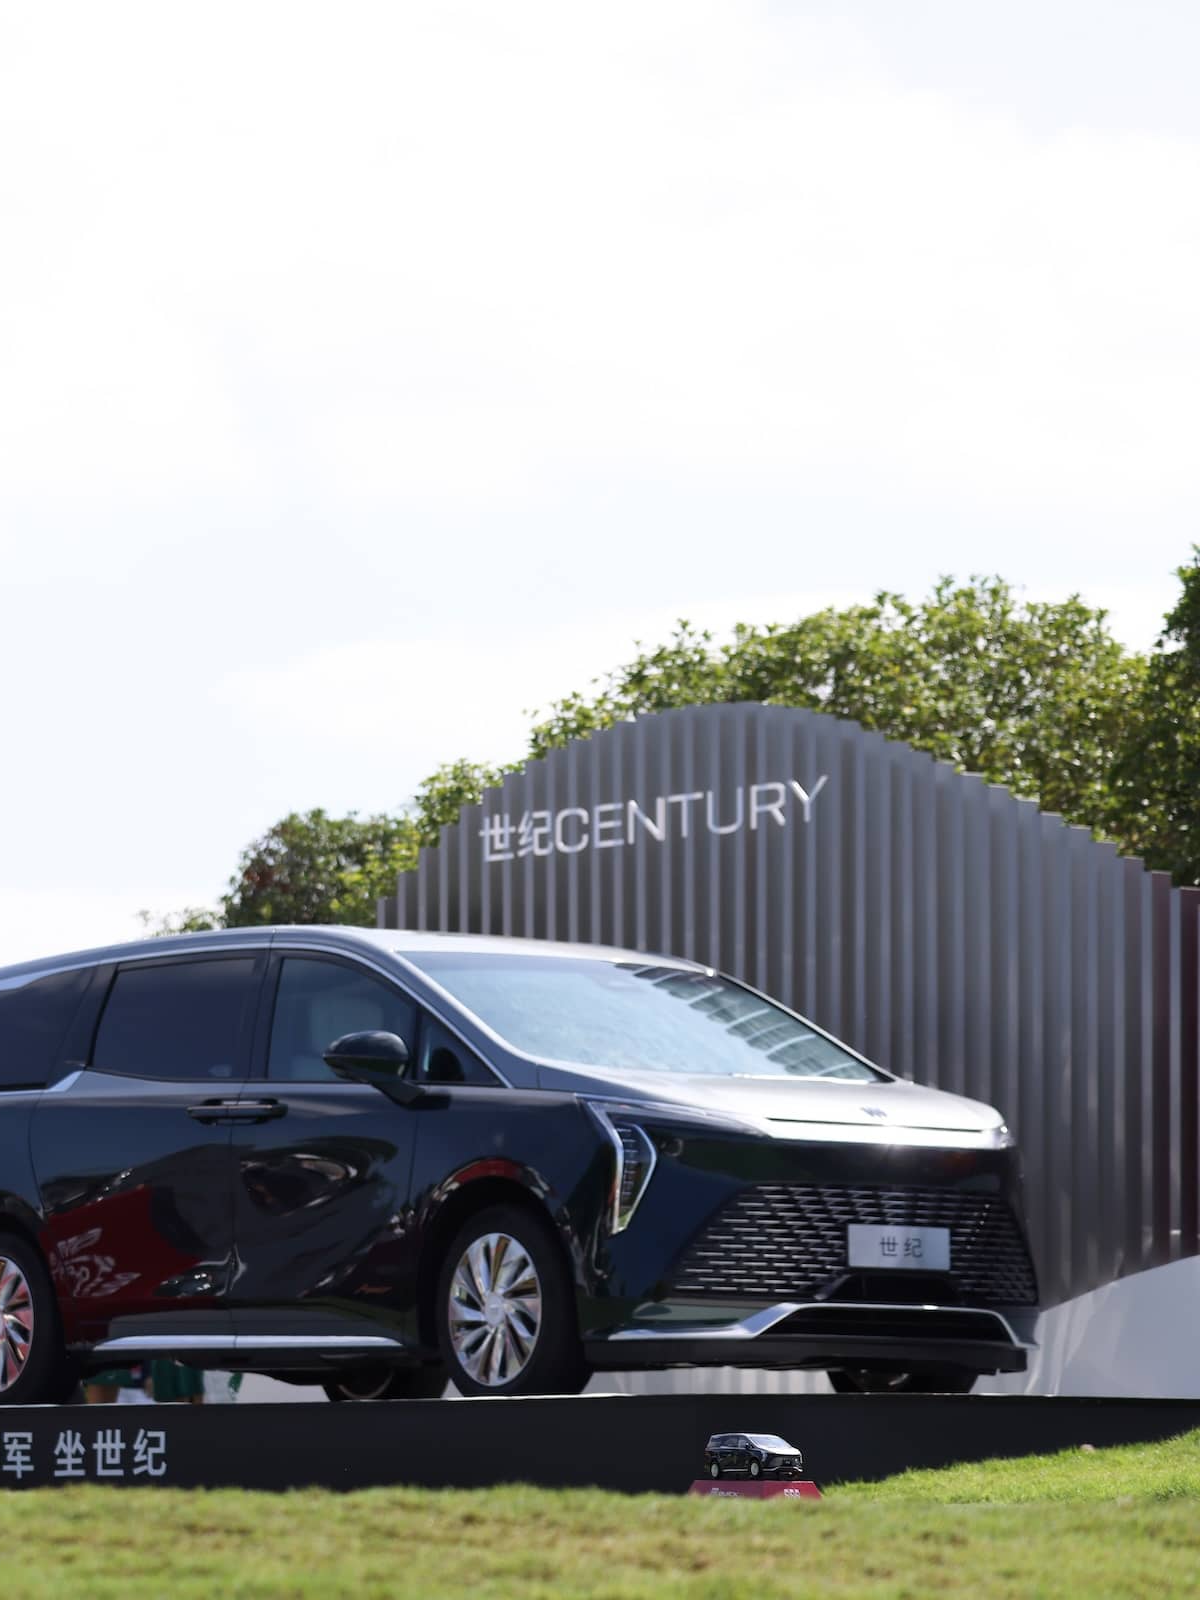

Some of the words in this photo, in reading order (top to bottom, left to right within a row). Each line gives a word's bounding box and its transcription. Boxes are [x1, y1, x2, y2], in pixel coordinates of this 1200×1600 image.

[479, 774, 829, 862] 世纪CENTURY
[880, 1236, 923, 1258] 世纪
[54, 1428, 167, 1477] 坐世纪
